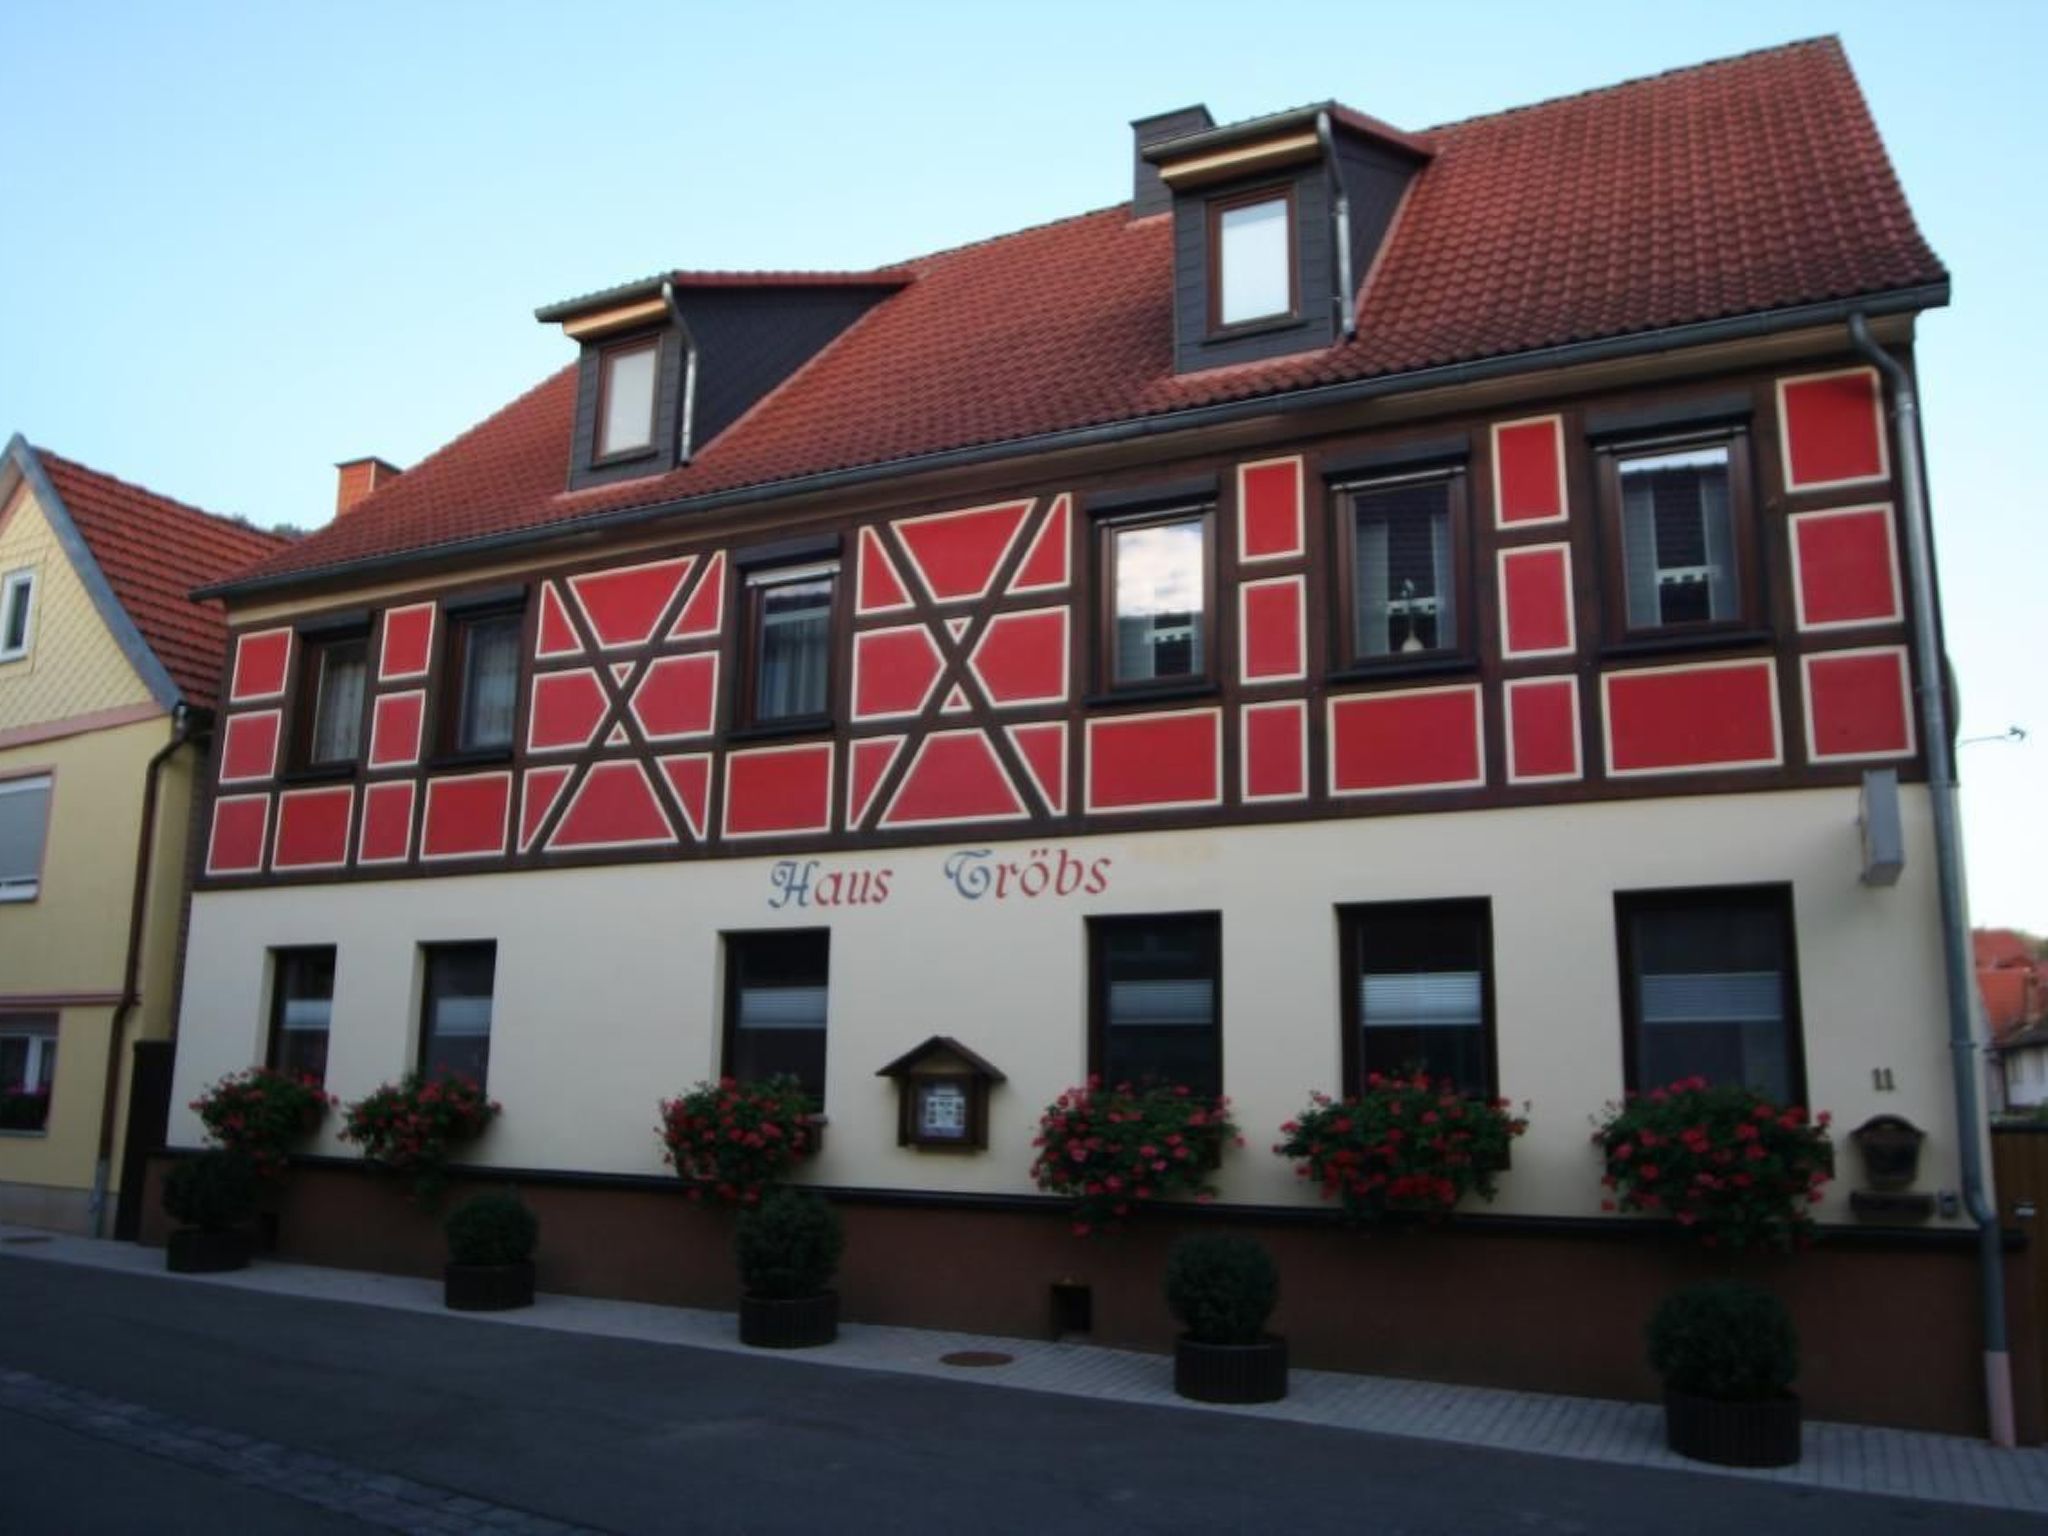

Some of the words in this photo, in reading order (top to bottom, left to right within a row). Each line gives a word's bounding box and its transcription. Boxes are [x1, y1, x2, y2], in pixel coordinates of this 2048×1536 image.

[768, 860, 893, 908] Haus
[944, 848, 1112, 900] Tröbs
[1872, 1067, 1896, 1092] 11
